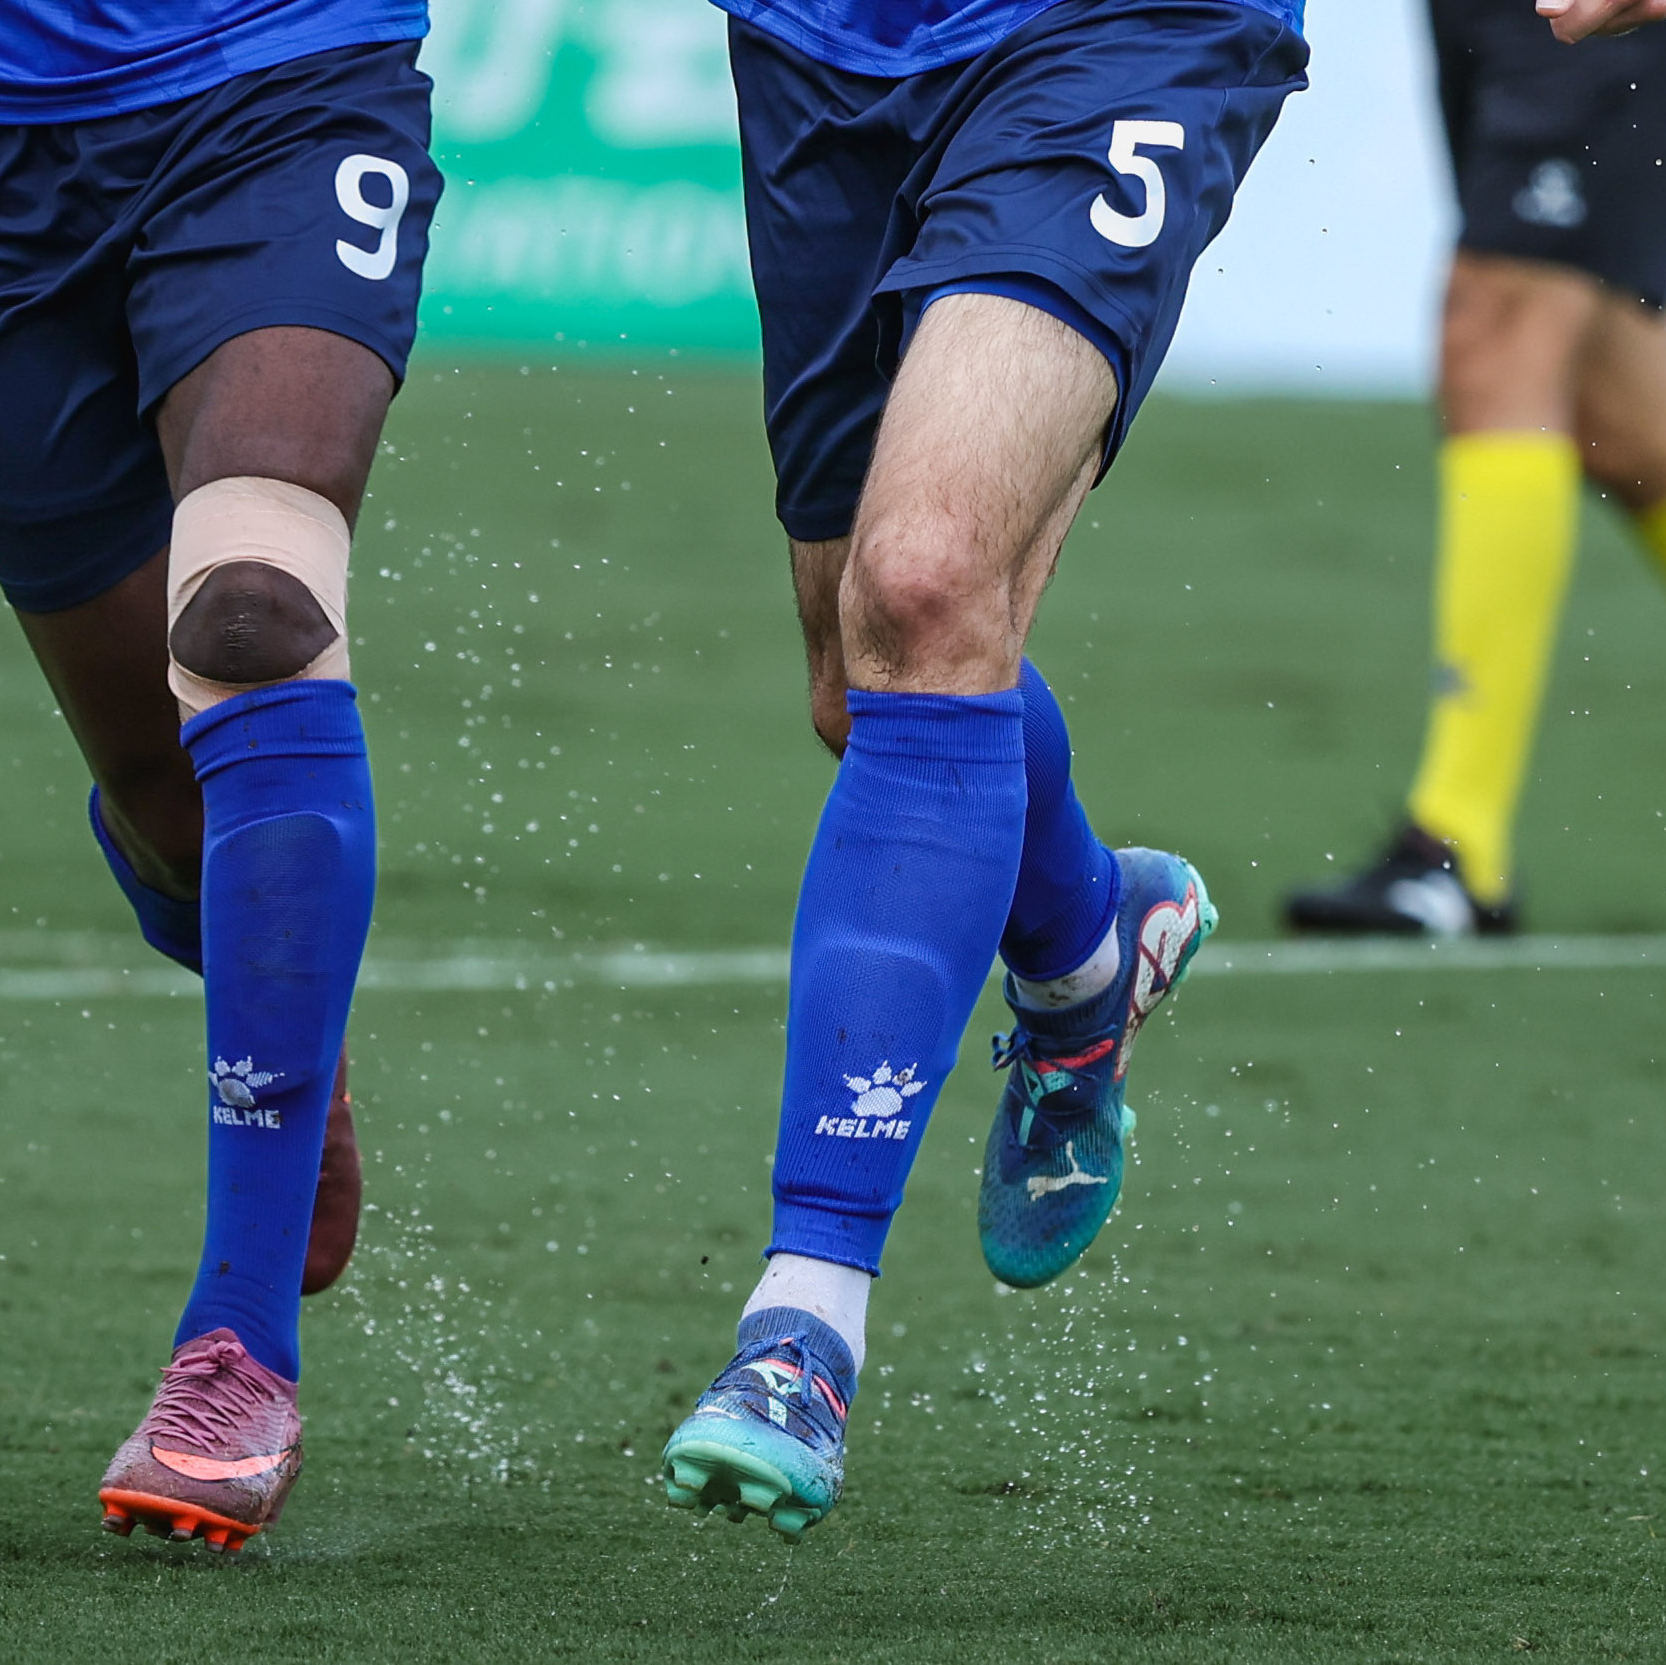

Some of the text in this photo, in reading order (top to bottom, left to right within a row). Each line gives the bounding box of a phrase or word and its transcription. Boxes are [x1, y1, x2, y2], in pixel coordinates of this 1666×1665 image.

[335, 153, 410, 281] 9
[1090, 120, 1185, 248] 5
[213, 1104, 281, 1129] KELME
[815, 1115, 912, 1140] KELME
